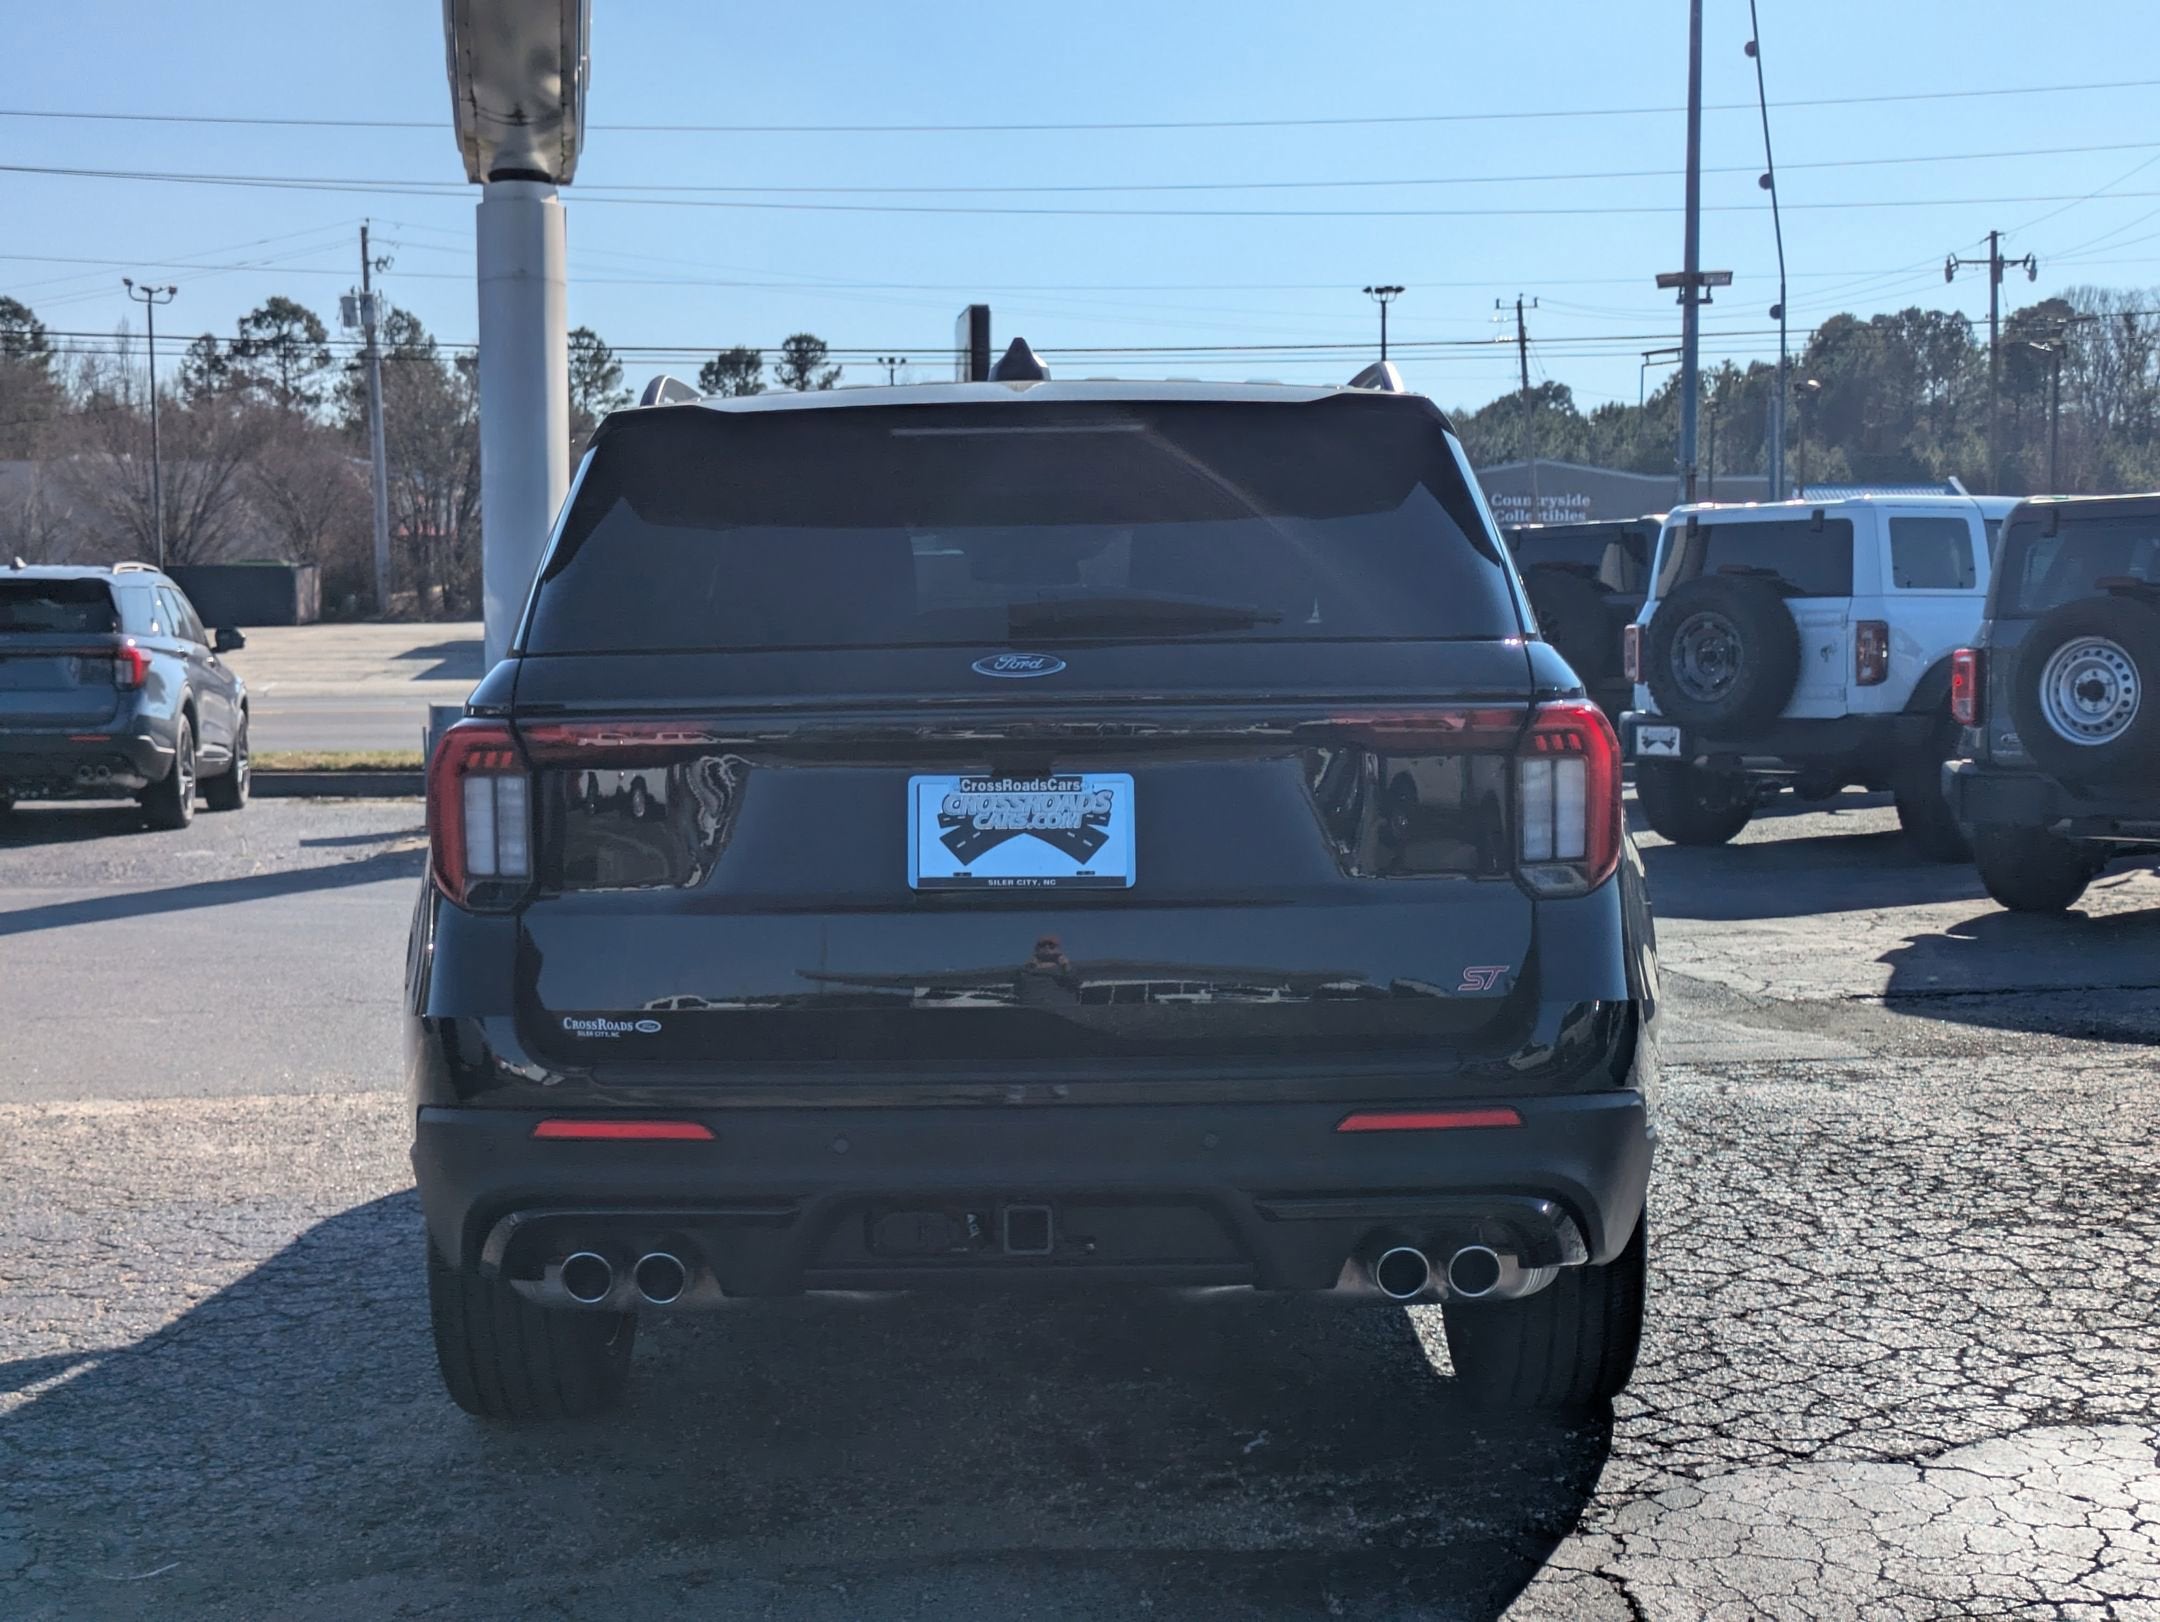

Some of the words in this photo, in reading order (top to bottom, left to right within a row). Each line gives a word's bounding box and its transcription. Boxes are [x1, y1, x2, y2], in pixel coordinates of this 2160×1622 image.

[1491, 494, 1591, 510] Counryside
[1493, 509, 1586, 522] Colletibles
[993, 655, 1045, 670] Ford
[961, 778, 1081, 792] CrossRoadsCars
[988, 879, 1014, 887] SILER
[1043, 879, 1057, 887] NC
[1457, 965, 1510, 991] ST
